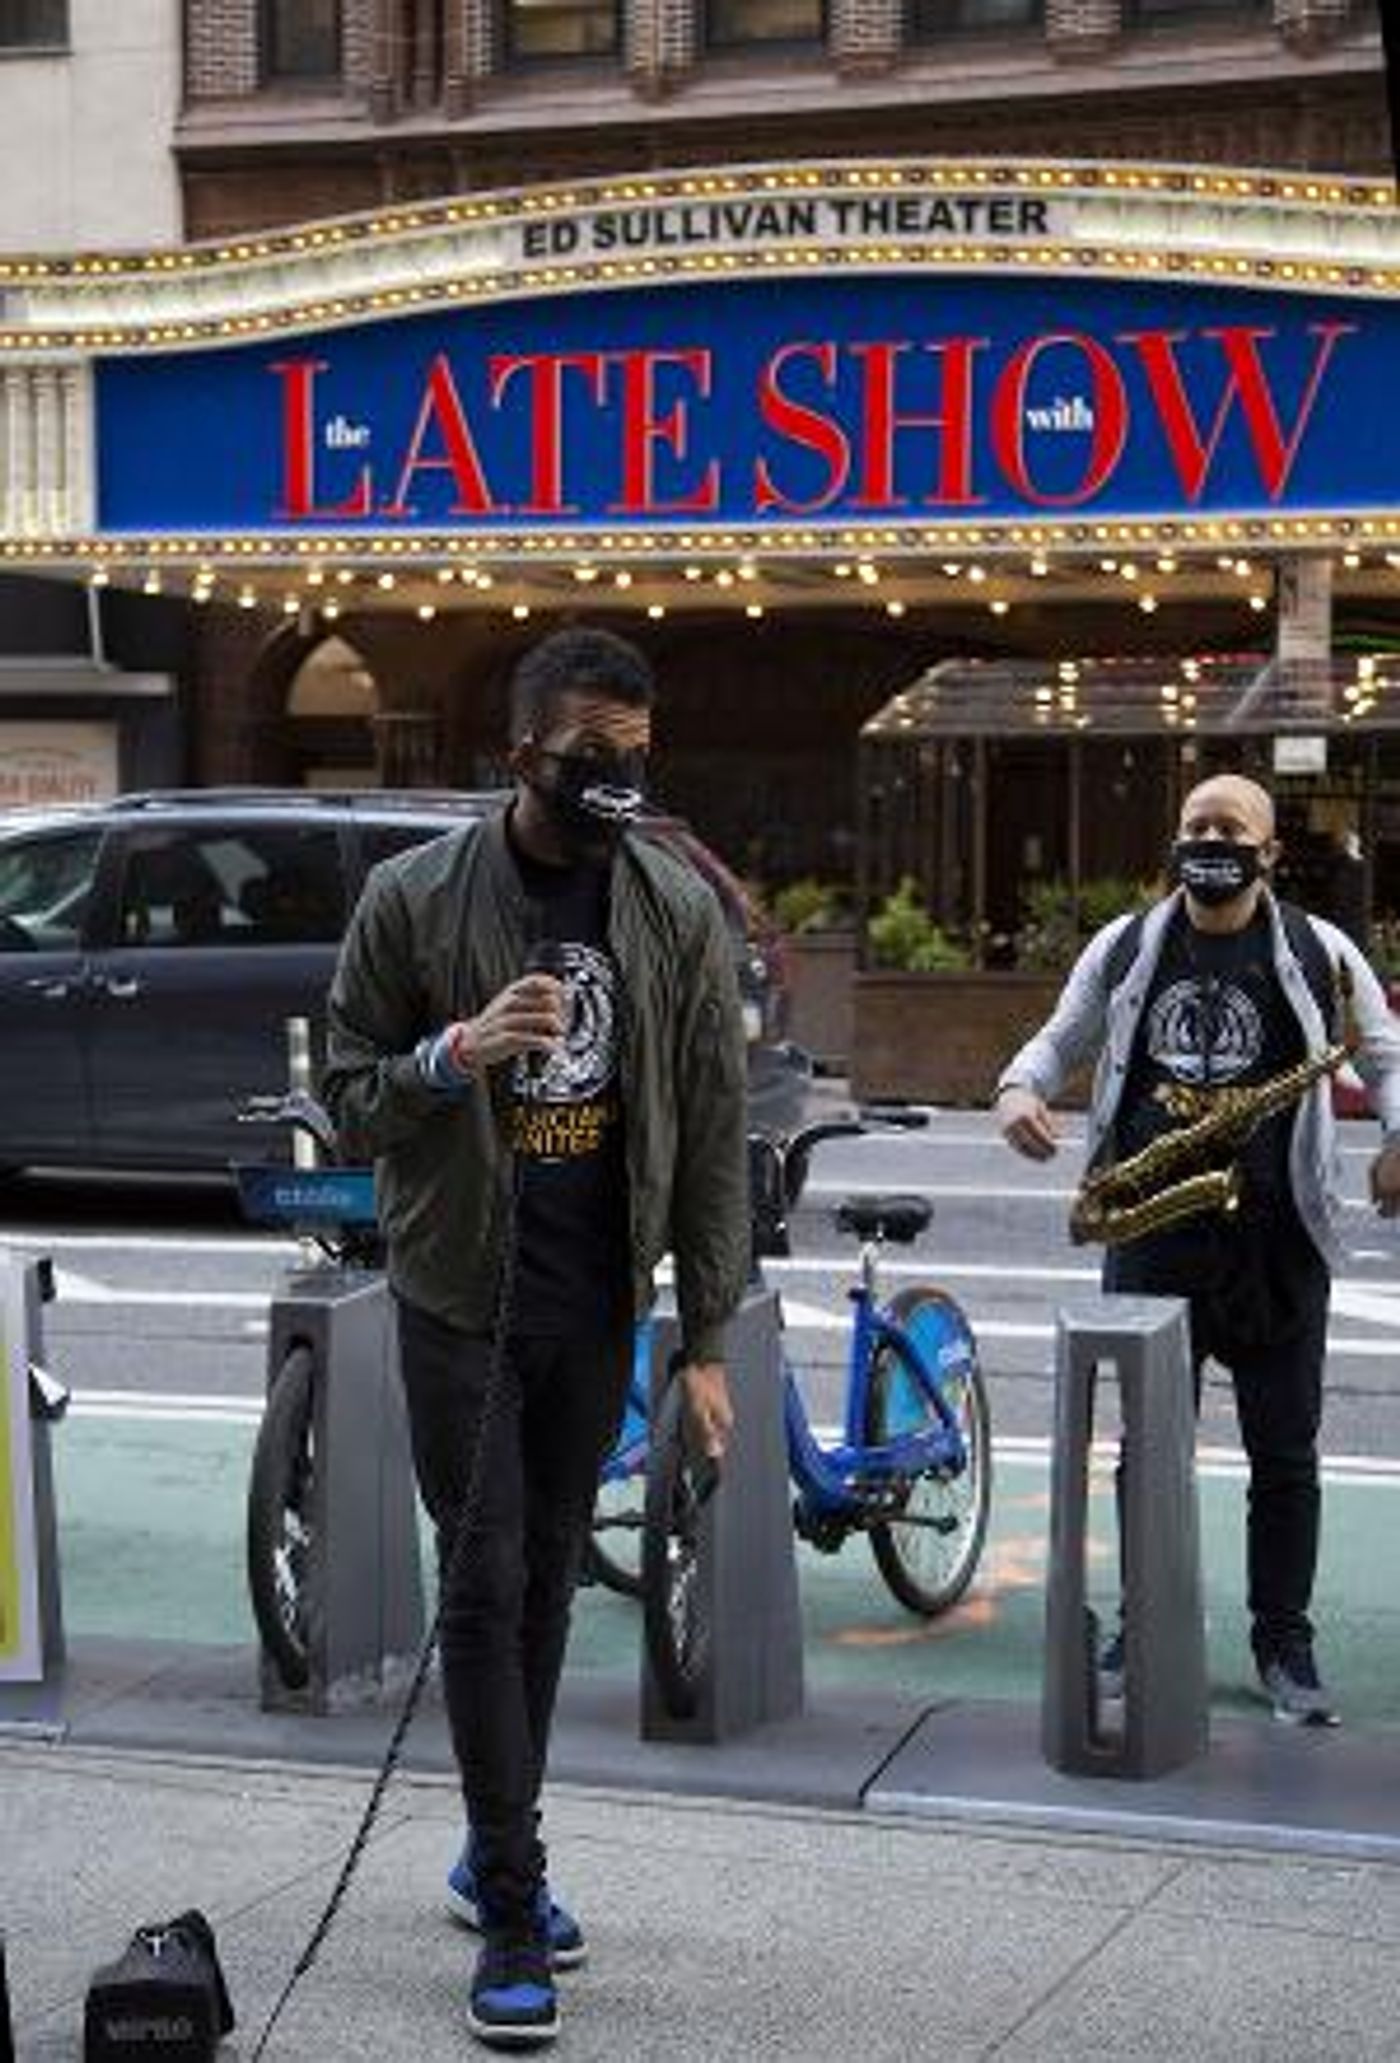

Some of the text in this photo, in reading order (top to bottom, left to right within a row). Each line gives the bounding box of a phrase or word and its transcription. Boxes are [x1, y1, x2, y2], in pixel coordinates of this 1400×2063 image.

[523, 199, 1048, 257] ED SULLIVAN THEATER
[267, 320, 1358, 518] LATE SHOW
[326, 416, 370, 448] the
[1026, 395, 1094, 432] with
